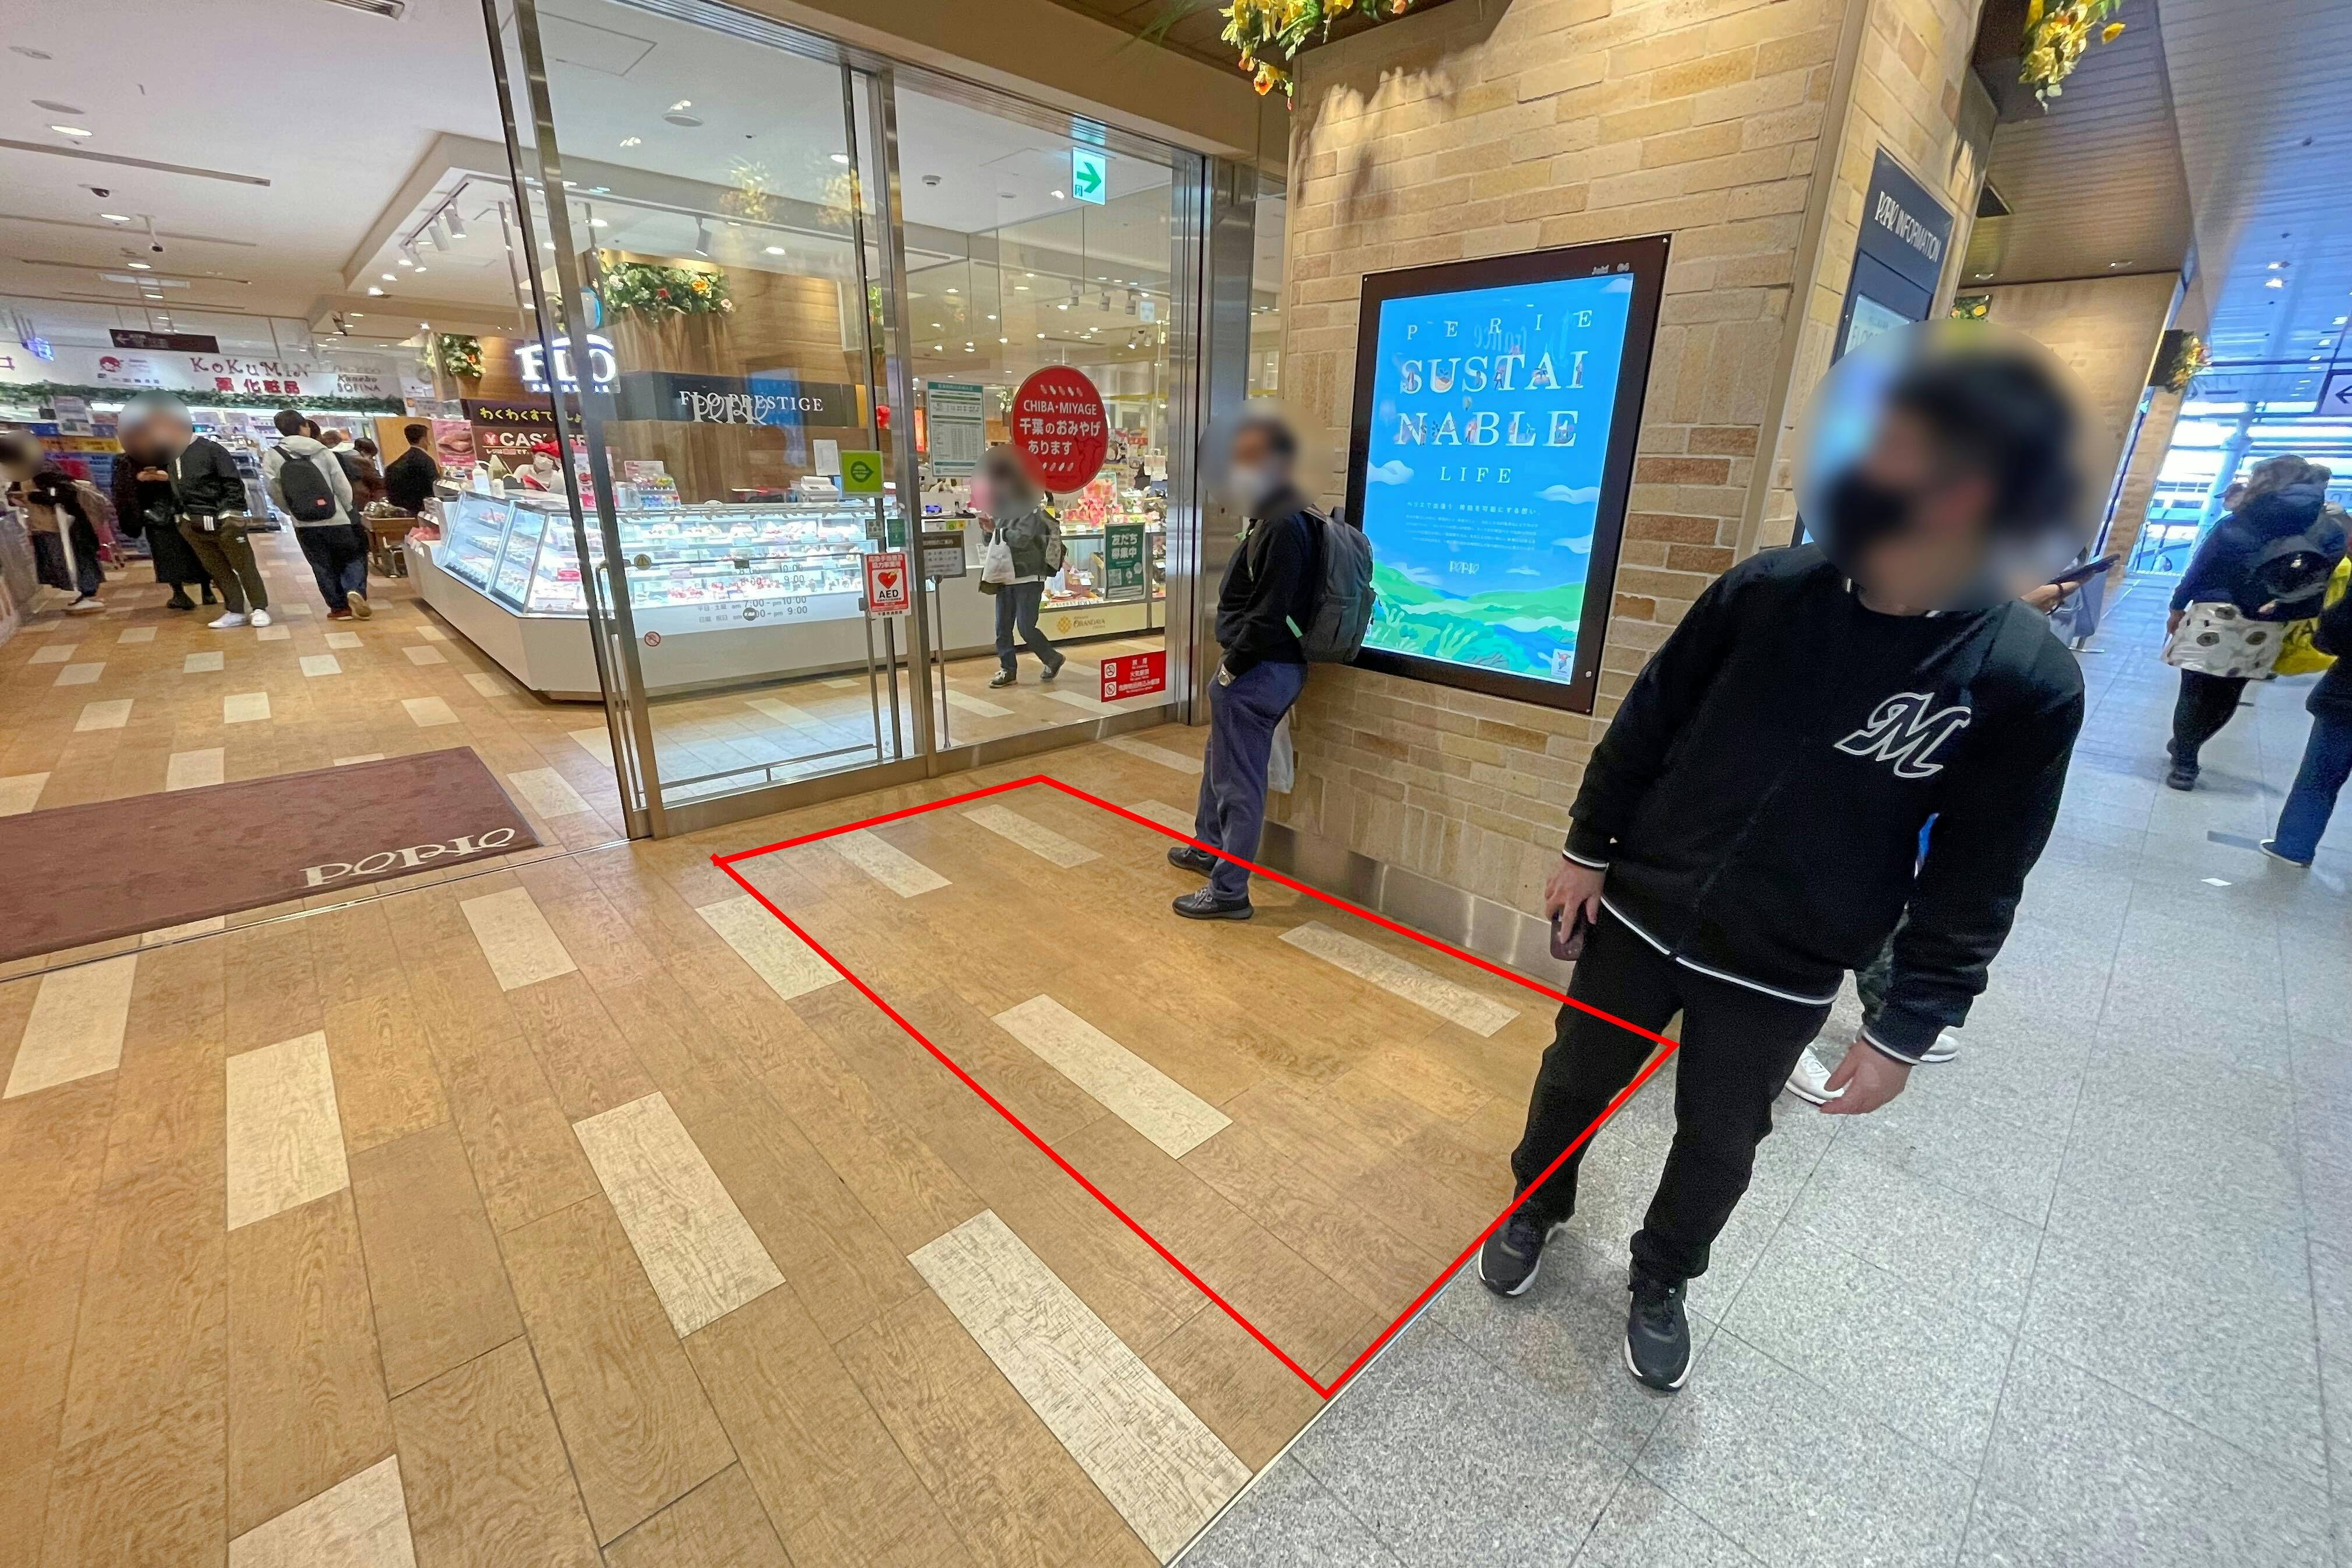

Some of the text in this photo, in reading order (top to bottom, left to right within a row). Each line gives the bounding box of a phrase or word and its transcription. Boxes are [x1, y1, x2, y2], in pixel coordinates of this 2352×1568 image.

[1895, 209, 1941, 262] INFORMATION
[1407, 310, 1593, 341] PERIE
[1400, 351, 1589, 394] SUSTAI
[1019, 418, 1101, 437] 千葉のおみやげ
[1394, 411, 1578, 447] NABLE
[1028, 439, 1072, 455] あります
[1440, 466, 1511, 484] LIFE
[879, 589, 899, 598] AED
[787, 606, 808, 615] 9:00
[1834, 692, 1972, 778] M
